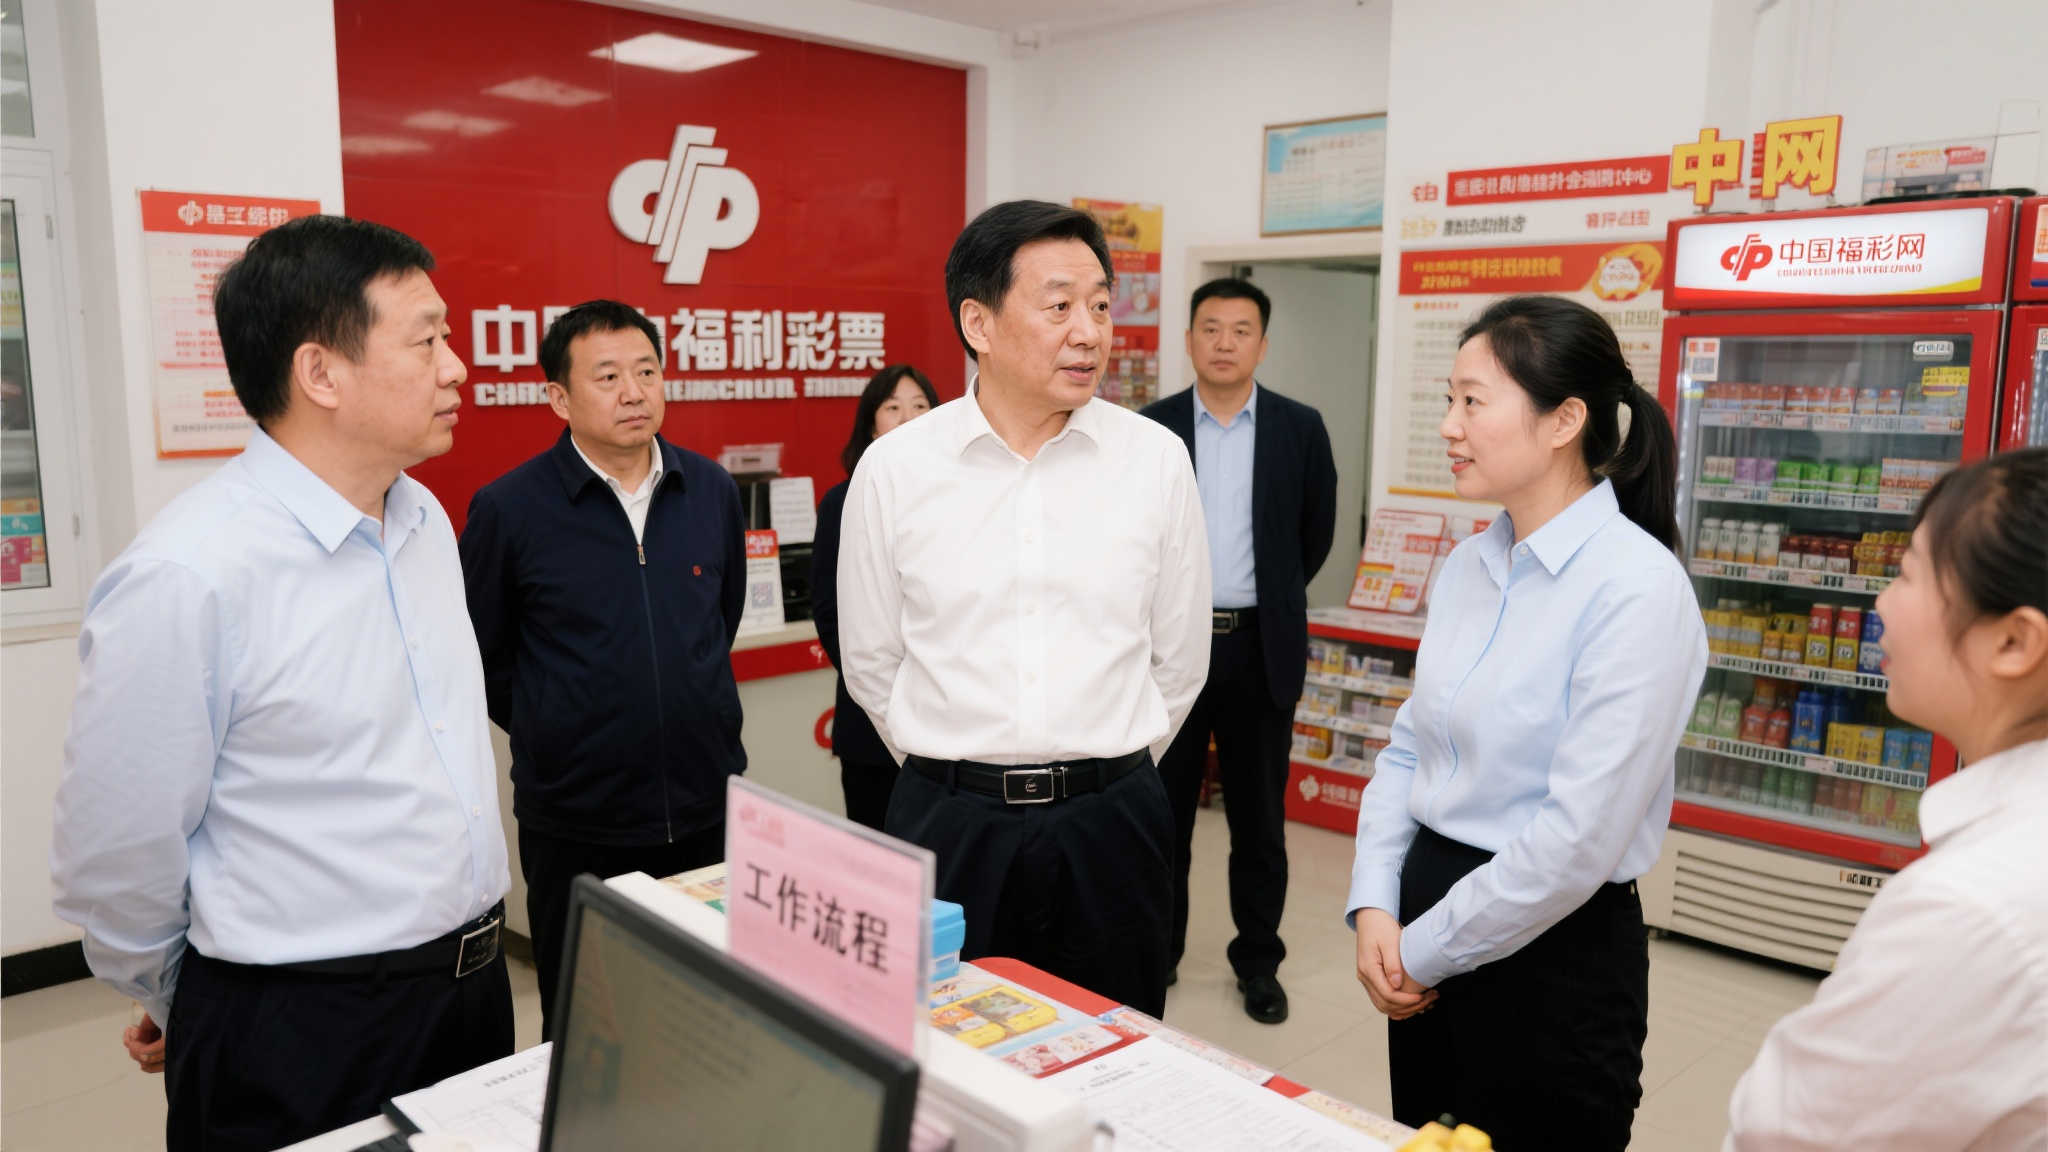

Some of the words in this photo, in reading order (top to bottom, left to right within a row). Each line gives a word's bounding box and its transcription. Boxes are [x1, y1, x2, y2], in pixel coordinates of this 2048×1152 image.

[1779, 233, 1925, 265] 中国福彩网
[471, 304, 886, 372] 中福利彩票
[743, 863, 889, 974] 工作流程
